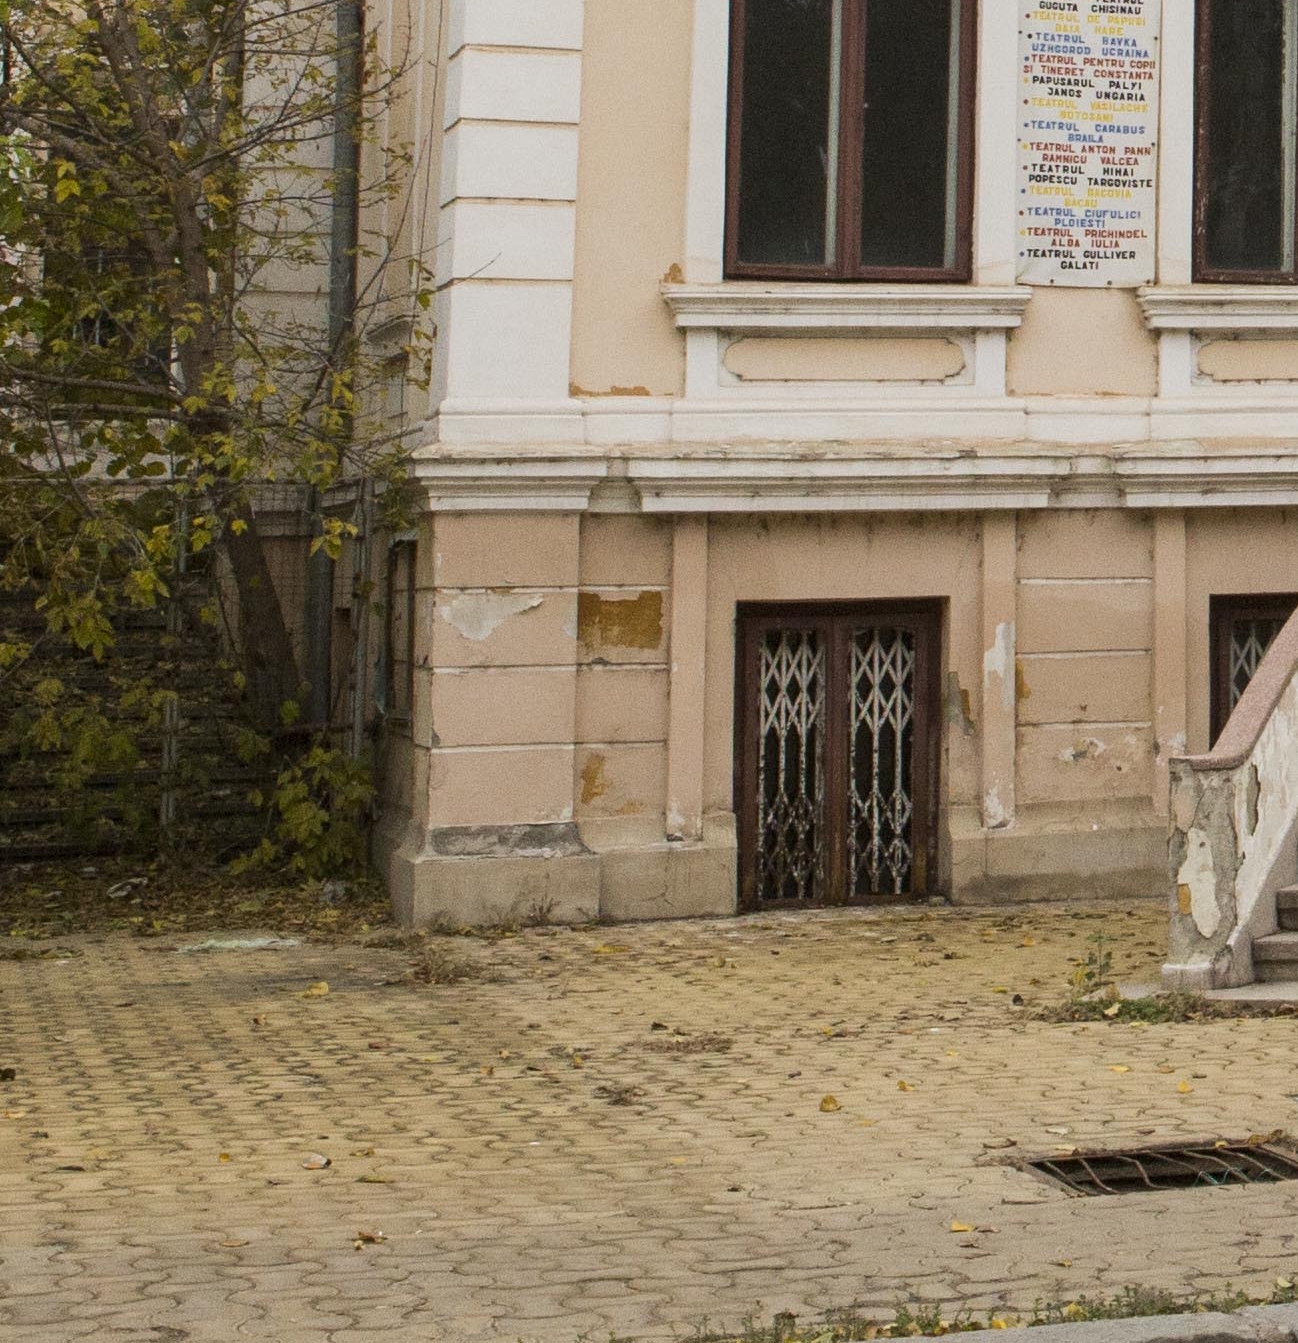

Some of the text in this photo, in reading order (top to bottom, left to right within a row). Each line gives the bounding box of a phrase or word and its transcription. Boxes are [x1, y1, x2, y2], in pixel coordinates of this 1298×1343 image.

[1091, 5, 1141, 15] CHISINAU
[1032, 11, 1080, 23] TEATRUL
[1035, 32, 1085, 43] TEATRUL
[1031, 43, 1149, 58] UZHGOROD UCRAINA
[1031, 54, 1155, 69] TEATRUL PENTRU COPII
[1023, 65, 1154, 80] SI TINERET CONSTANTA
[1032, 75, 1095, 88] PAPUSARUL
[1047, 87, 1145, 102] JANOS UNGARIA
[1031, 97, 1078, 109] TEATRUL
[1031, 120, 1145, 134] TEATRUL CARABUS
[1068, 133, 1104, 143] BRAILA
[1030, 142, 1151, 155] TEATRUL ANTON PANN
[1042, 154, 1139, 166] RAMNICU VALCEA
[1031, 163, 1085, 174] TEATRUL
[1028, 174, 1152, 188] POPESCU TARGOVISTE
[1027, 207, 1141, 219] TEATRUL CIUFULICI
[1054, 218, 1105, 228] PLOIESTI
[1027, 227, 1148, 238] TEATRUL PRICHINDEL
[1051, 239, 1120, 248] ALBA IULIA
[1027, 249, 1136, 259] TEATRUL GULLIVER
[1060, 261, 1100, 270] GALATI
